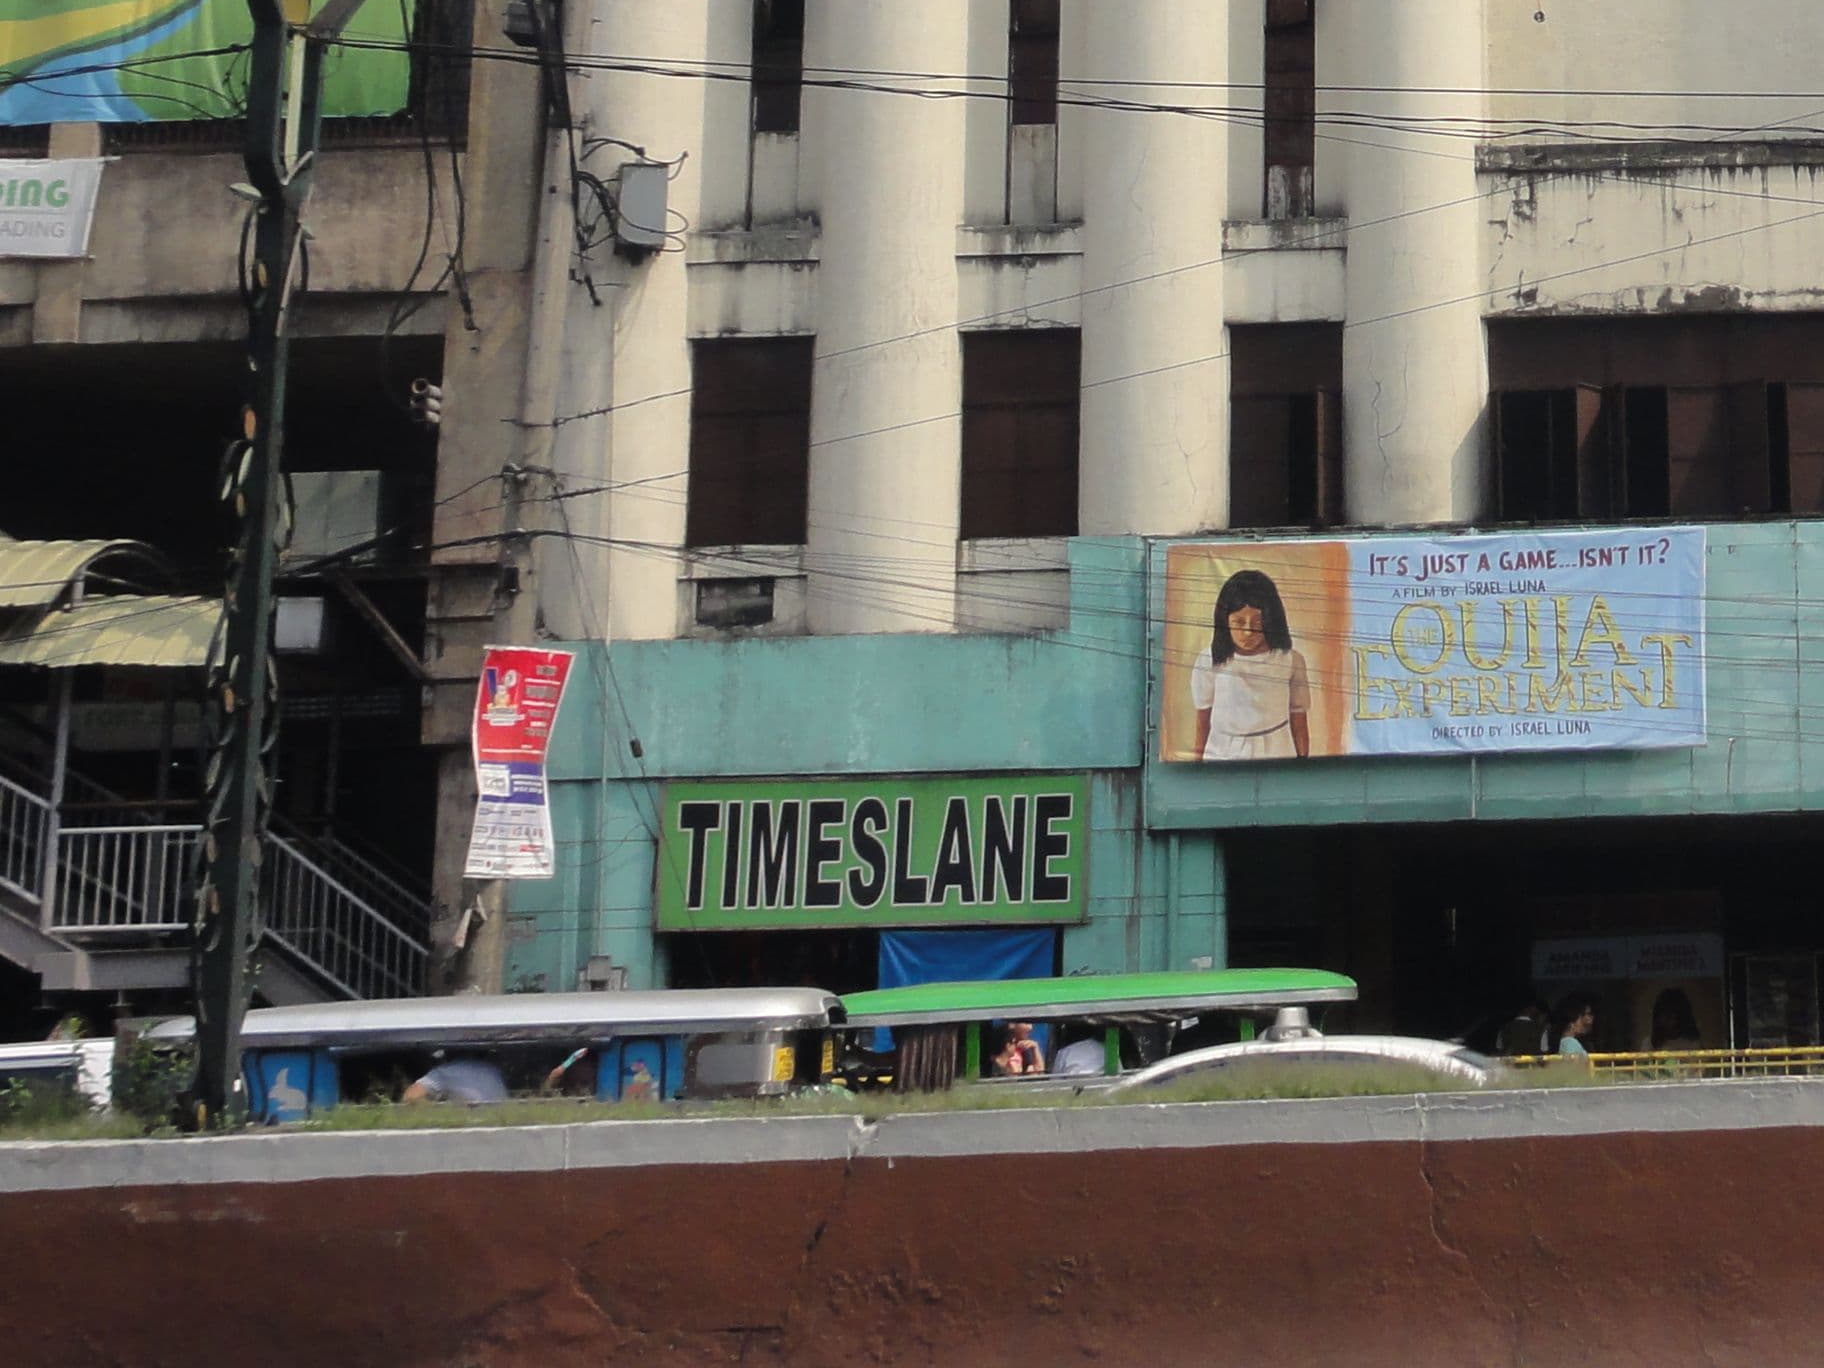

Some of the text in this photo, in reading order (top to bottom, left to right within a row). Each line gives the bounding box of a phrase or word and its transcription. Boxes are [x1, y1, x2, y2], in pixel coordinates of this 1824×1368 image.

[1369, 553, 1409, 577] IT'S
[1414, 553, 1468, 581] JUST
[1477, 552, 1490, 573] A
[1639, 537, 1671, 566] IT?
[1392, 579, 1546, 599] A FILM BY ISRAEL LUNA
[1391, 594, 1638, 682] OUIJA
[1351, 634, 1694, 721] EXPERIMENT
[1432, 719, 1592, 740] DIRECTED BY ISRAEL LUNA
[678, 793, 1073, 910] TIMESLANE
